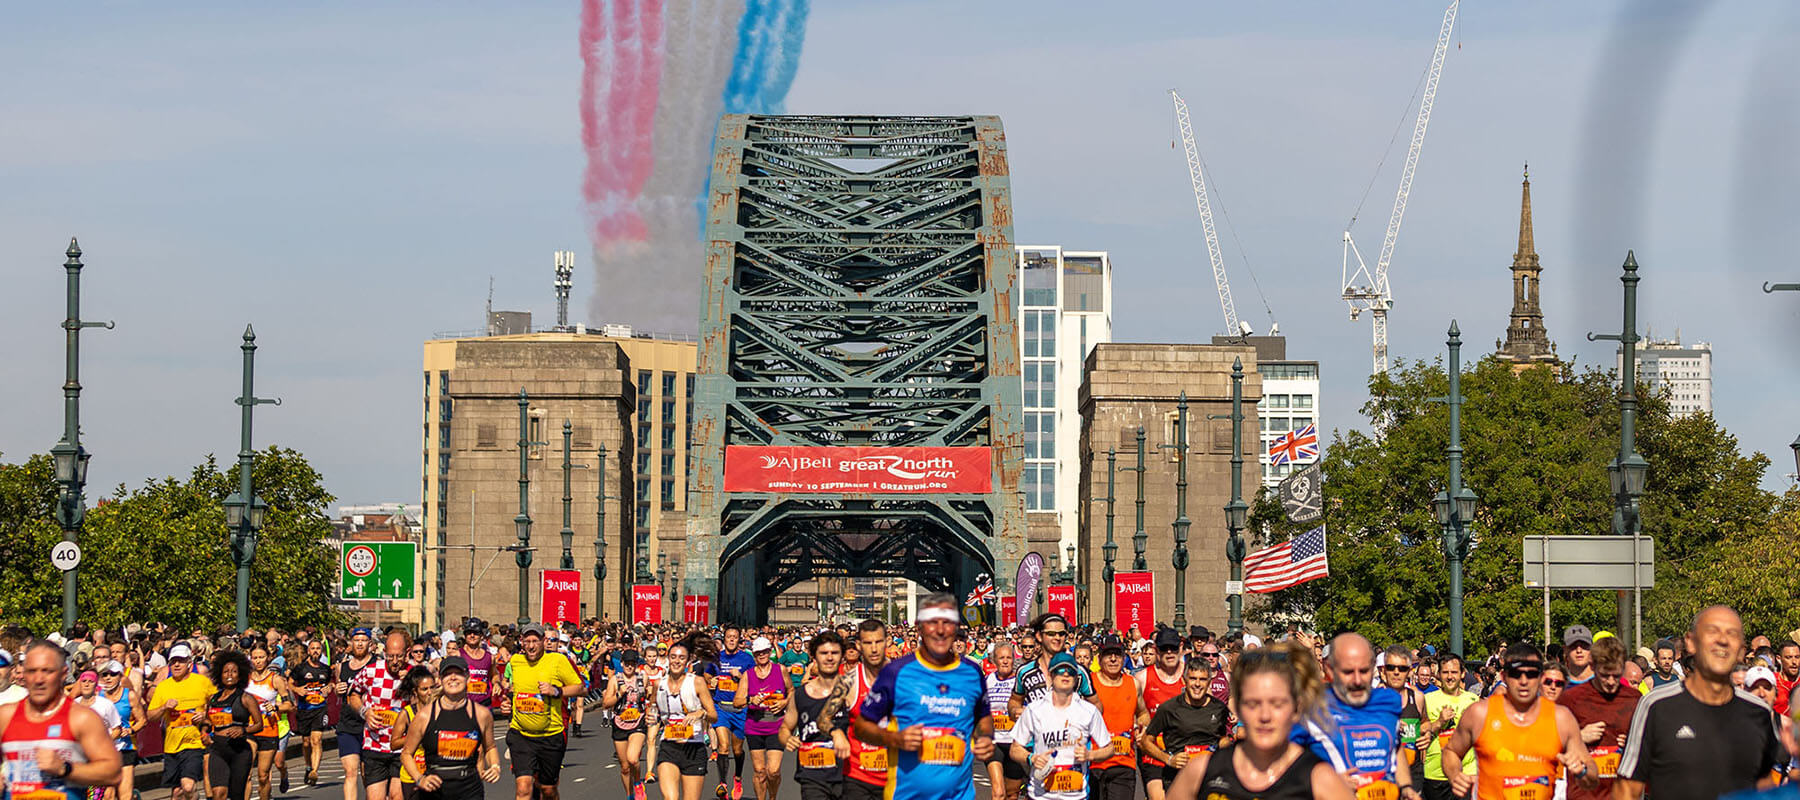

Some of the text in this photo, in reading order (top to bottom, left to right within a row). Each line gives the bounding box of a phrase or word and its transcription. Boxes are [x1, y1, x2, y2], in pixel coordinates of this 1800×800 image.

[778, 456, 954, 472] AJBell great north
[925, 469, 957, 479] run
[880, 481, 948, 490] GREATRUN.ORG
[56, 549, 77, 561] 40
[552, 581, 578, 592] AJBell
[1125, 583, 1151, 593] AJBell
[557, 600, 567, 619] Feel
[1131, 602, 1140, 621] Feel
[920, 694, 967, 706] Alzheimer's
[927, 703, 961, 717] Society
[1042, 728, 1069, 746] VALE
